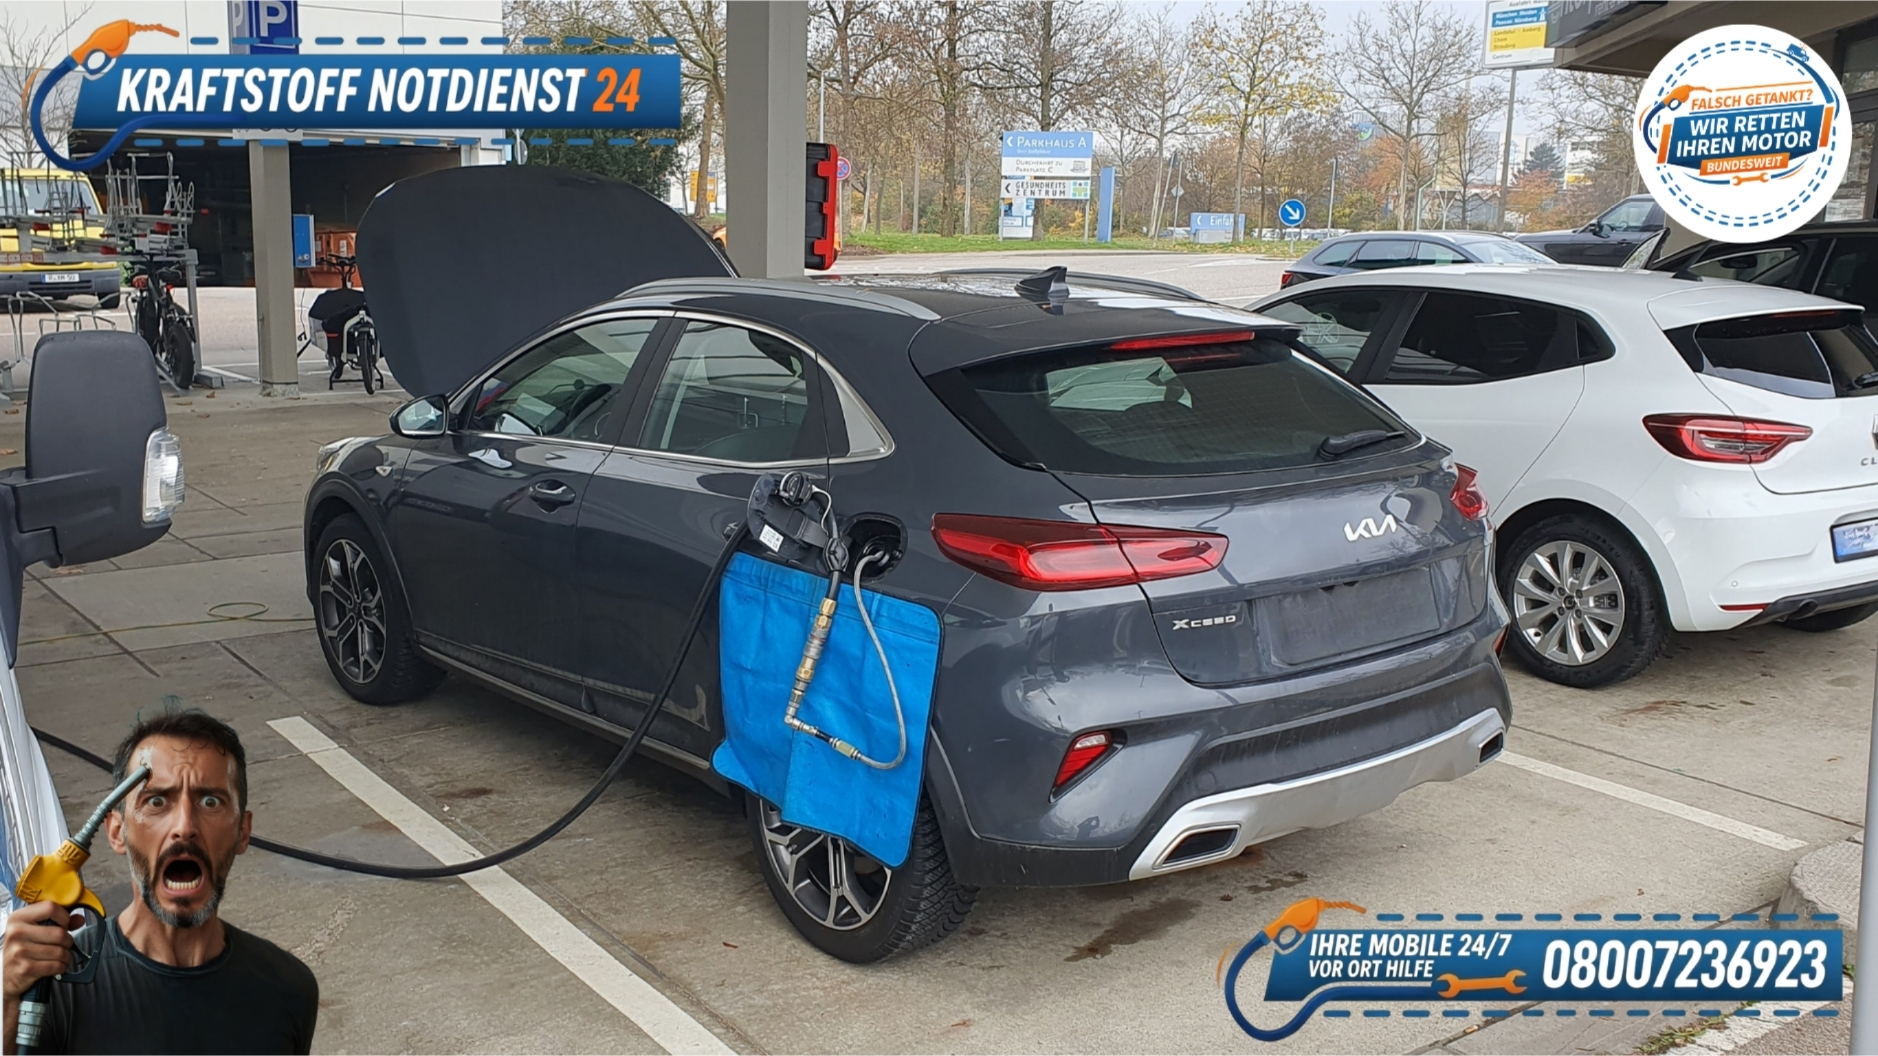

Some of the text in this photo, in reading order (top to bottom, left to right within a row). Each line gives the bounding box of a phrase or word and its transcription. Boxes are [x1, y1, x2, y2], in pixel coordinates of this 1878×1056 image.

[259, 0, 288, 37] P
[1017, 136, 1087, 148] PARKHAUS A
[1015, 181, 1066, 189] GESUNDHEITS
[1015, 189, 1066, 197] ZENTRUM
[1210, 214, 1241, 226] Einfah
